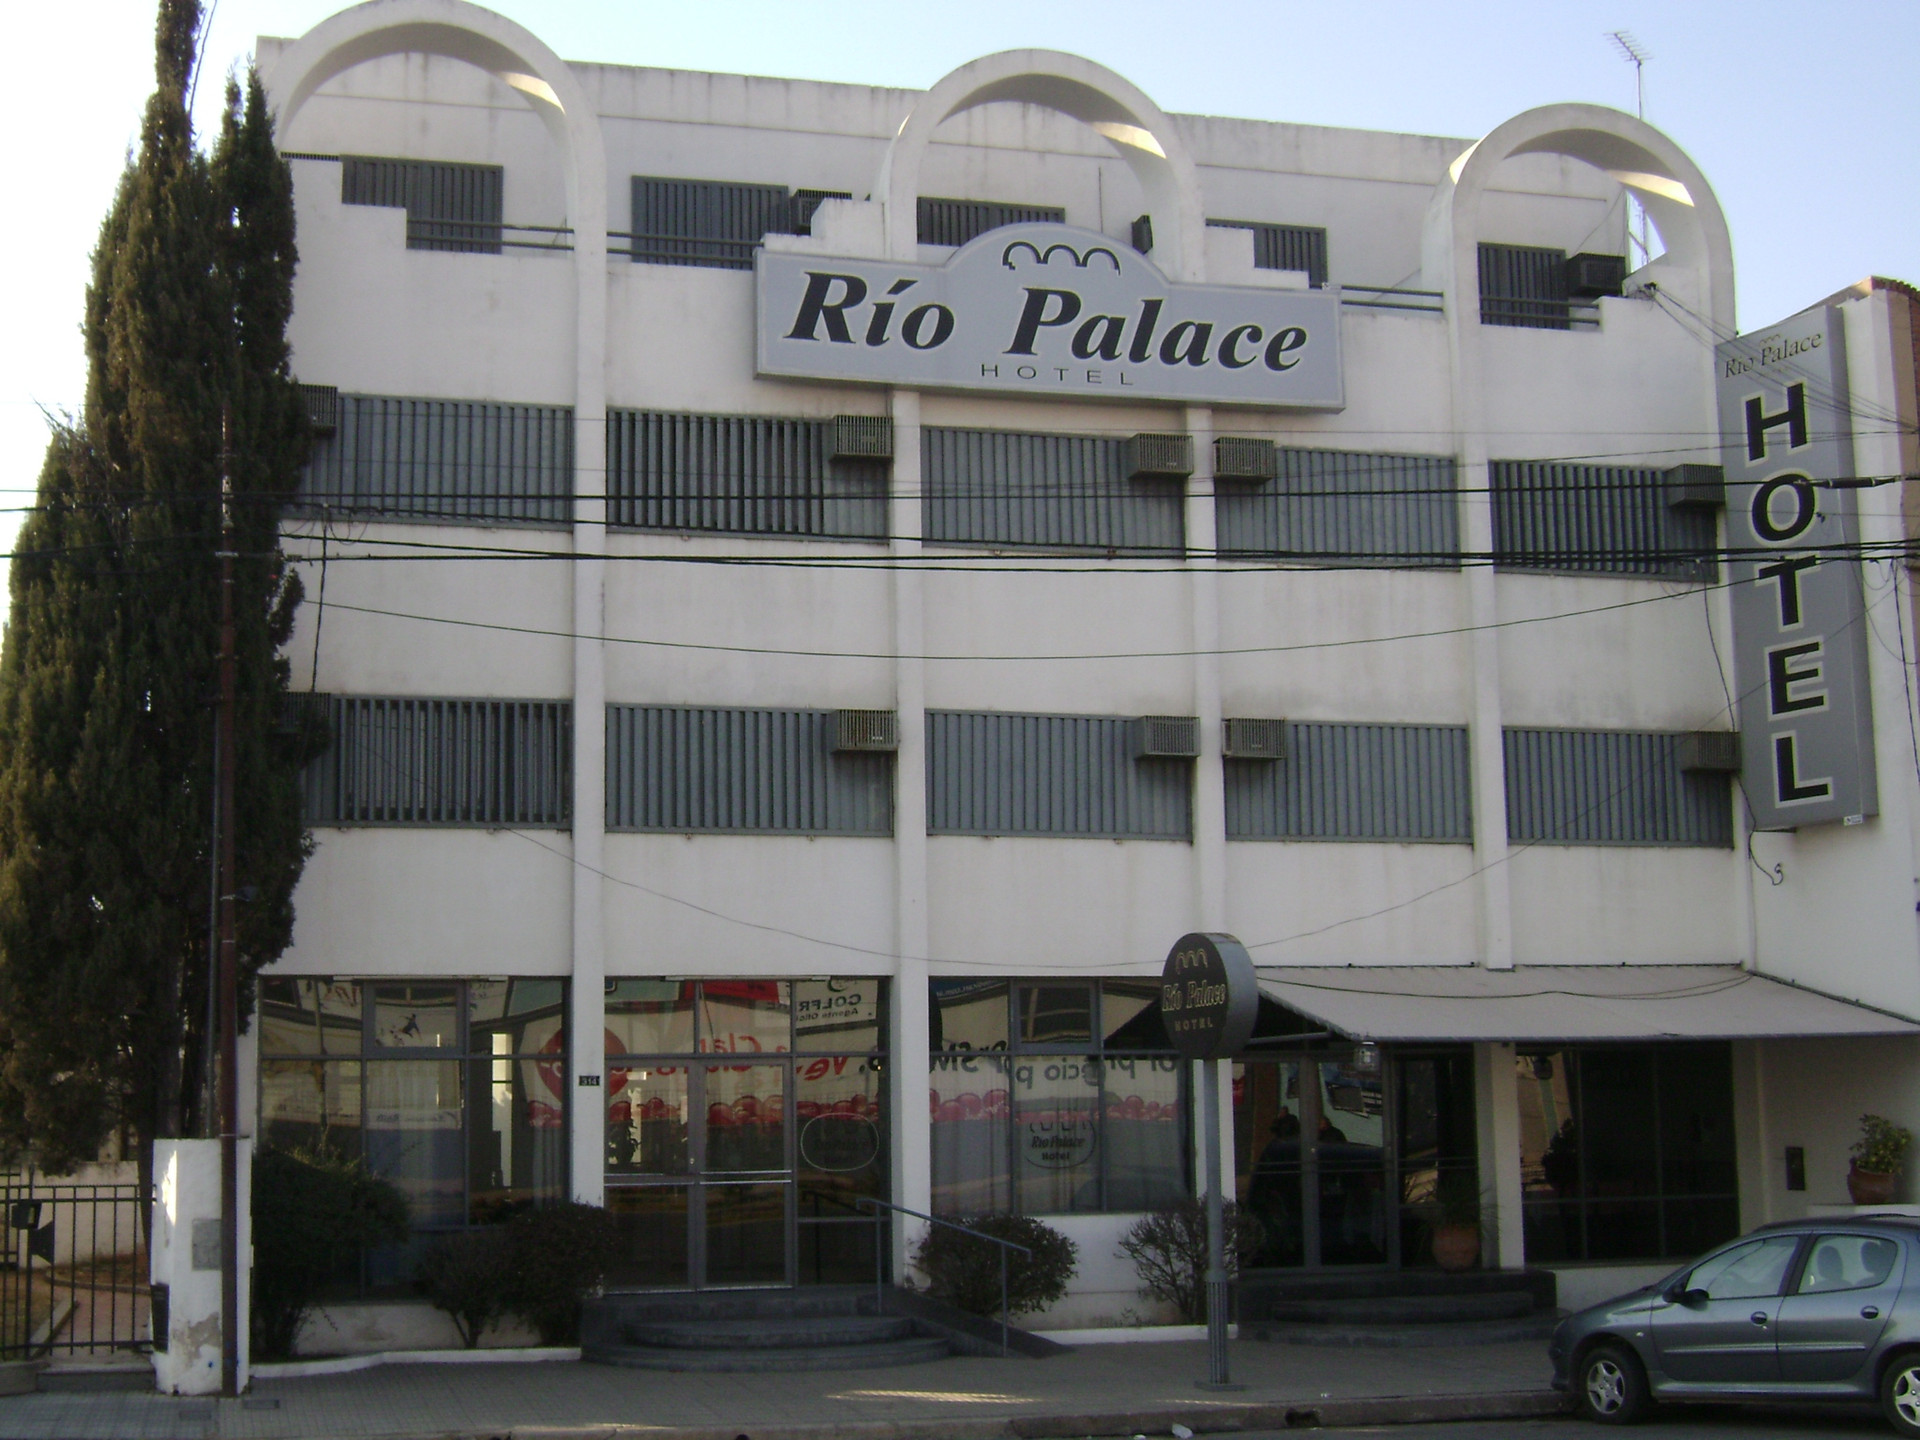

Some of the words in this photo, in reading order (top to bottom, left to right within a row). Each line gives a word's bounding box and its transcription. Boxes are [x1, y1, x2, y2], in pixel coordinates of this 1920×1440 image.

[783, 271, 955, 350] Río
[1002, 287, 1308, 372] Palace
[1760, 333, 1823, 367] Palace
[980, 363, 1134, 386] HOTEL
[1746, 383, 1830, 802] HOTEL
[1186, 979, 1226, 1009] Palace
[1174, 1017, 1214, 1032] HOTEL
